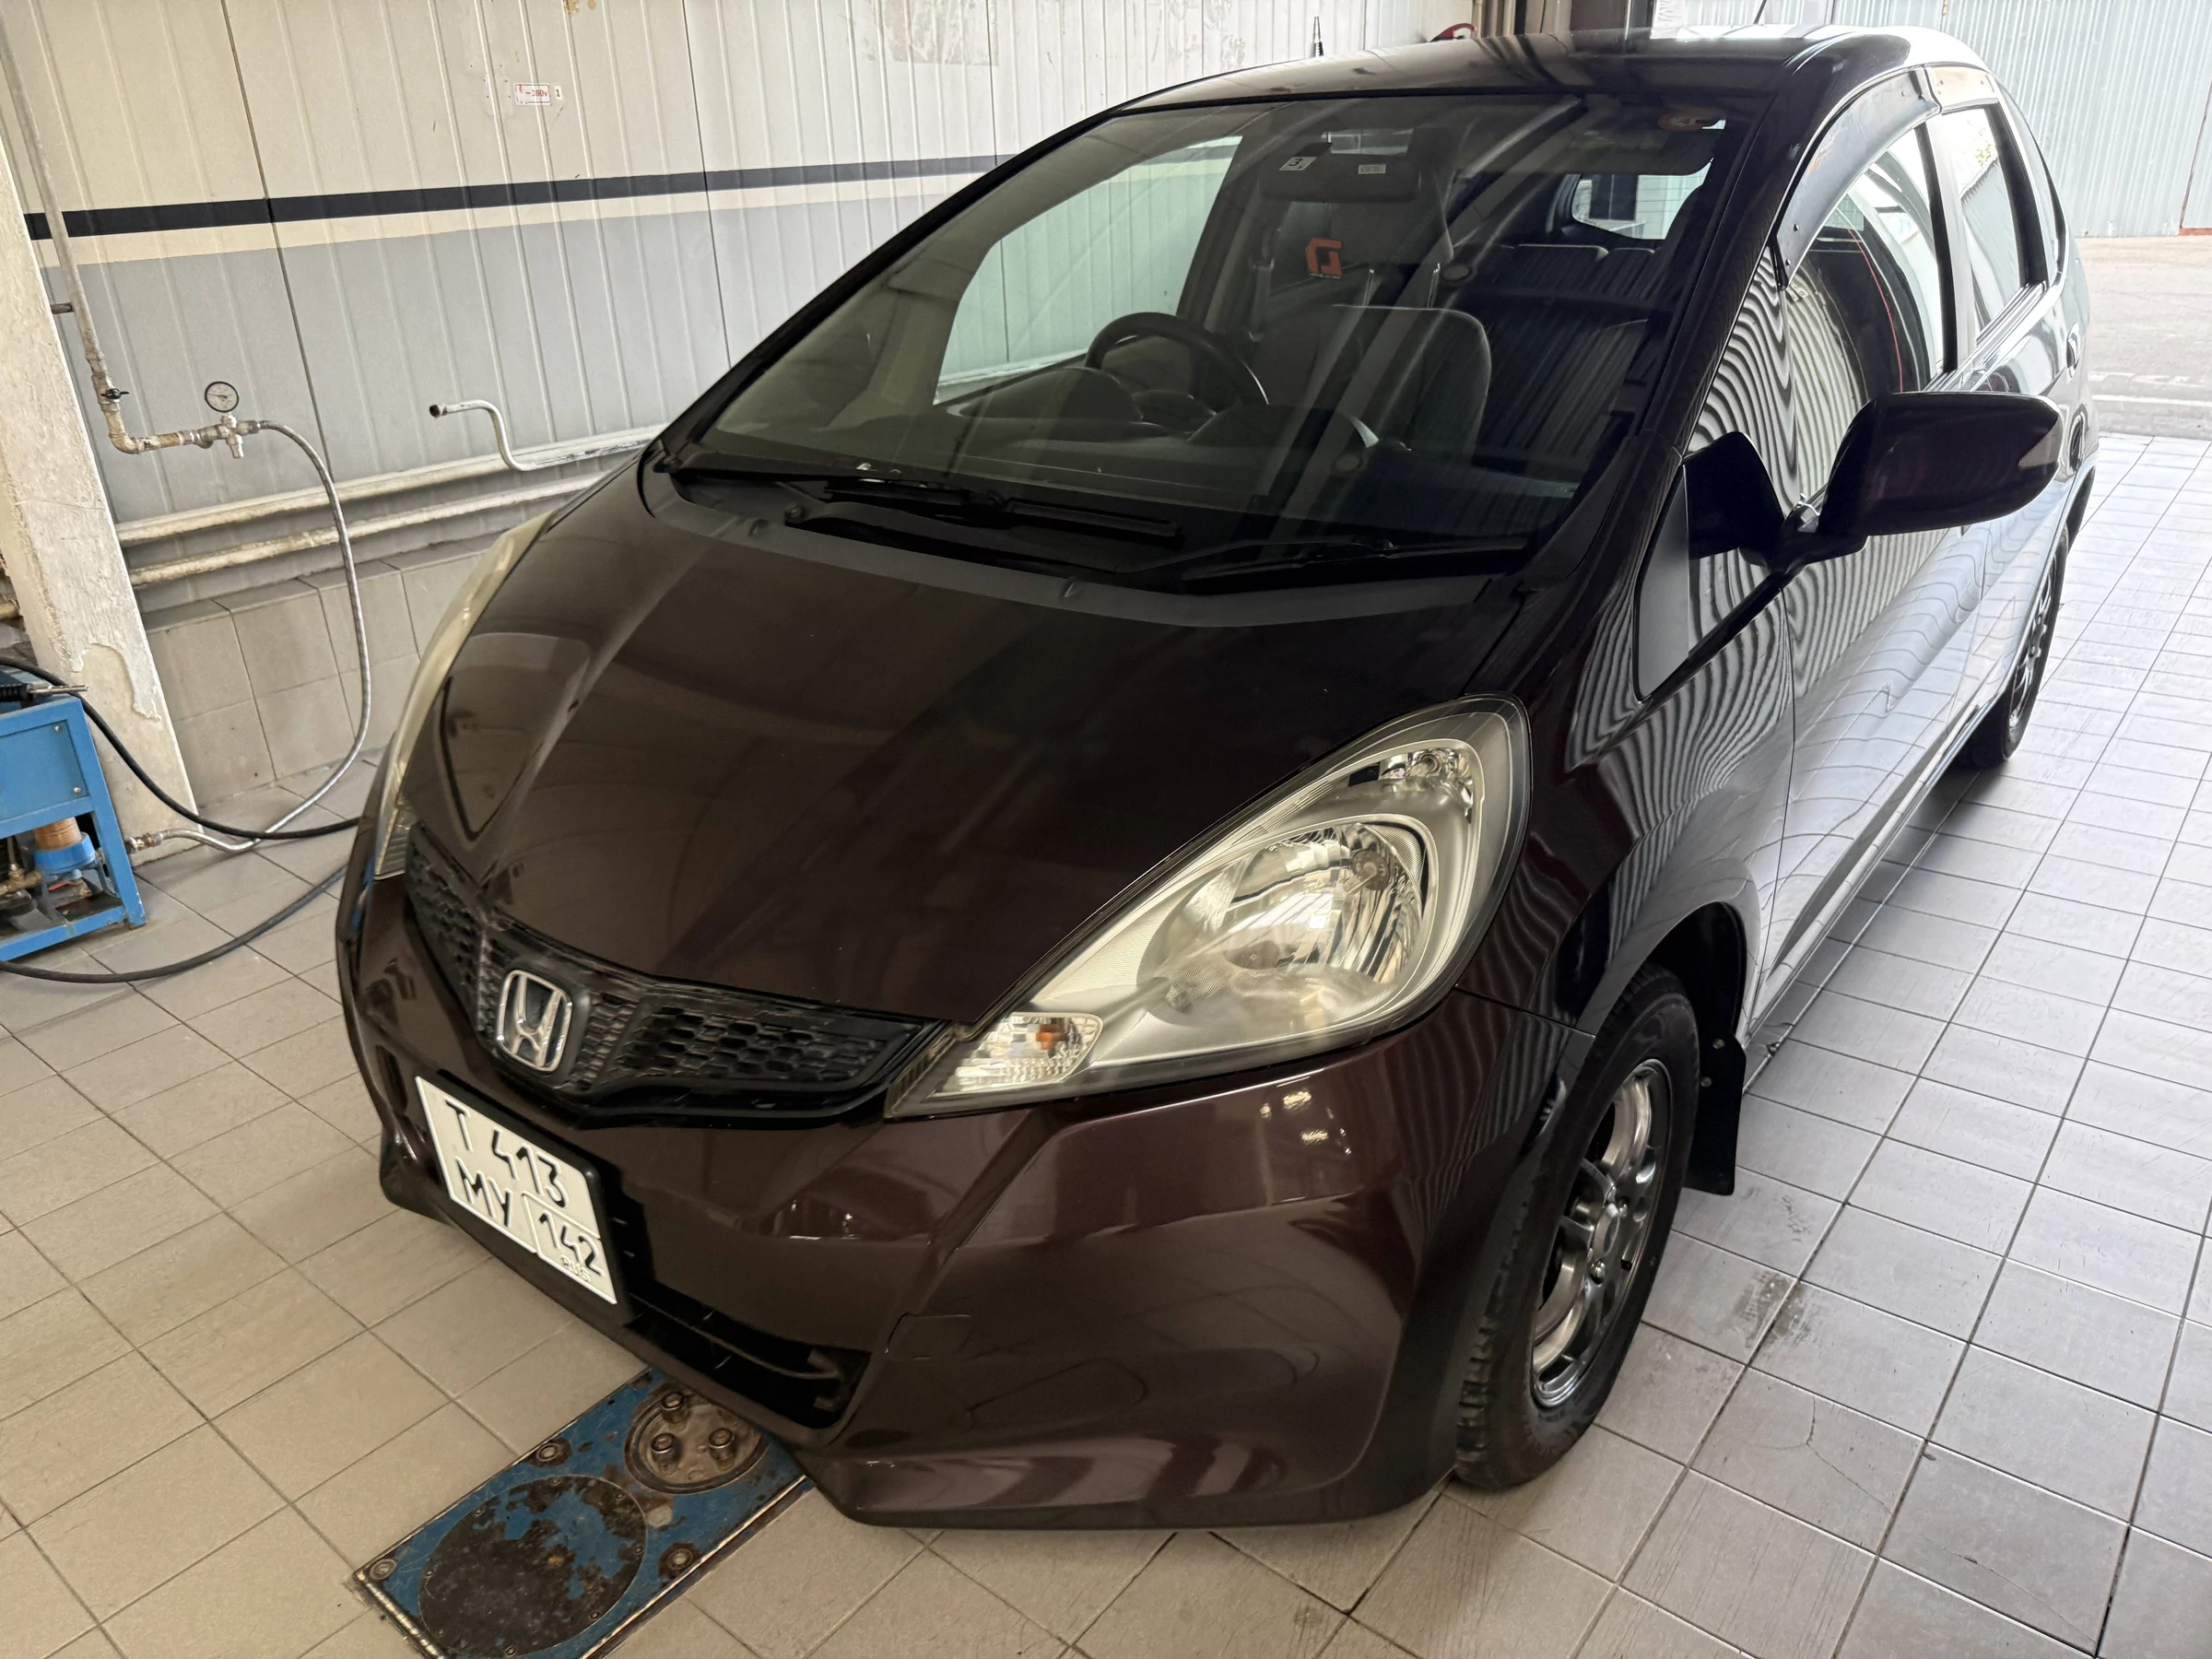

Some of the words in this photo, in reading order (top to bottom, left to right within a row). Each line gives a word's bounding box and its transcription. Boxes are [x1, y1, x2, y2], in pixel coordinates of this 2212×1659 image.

[556, 88, 560, 97] 1
[491, 1126, 570, 1208] 413
[538, 1209, 606, 1277] 142
